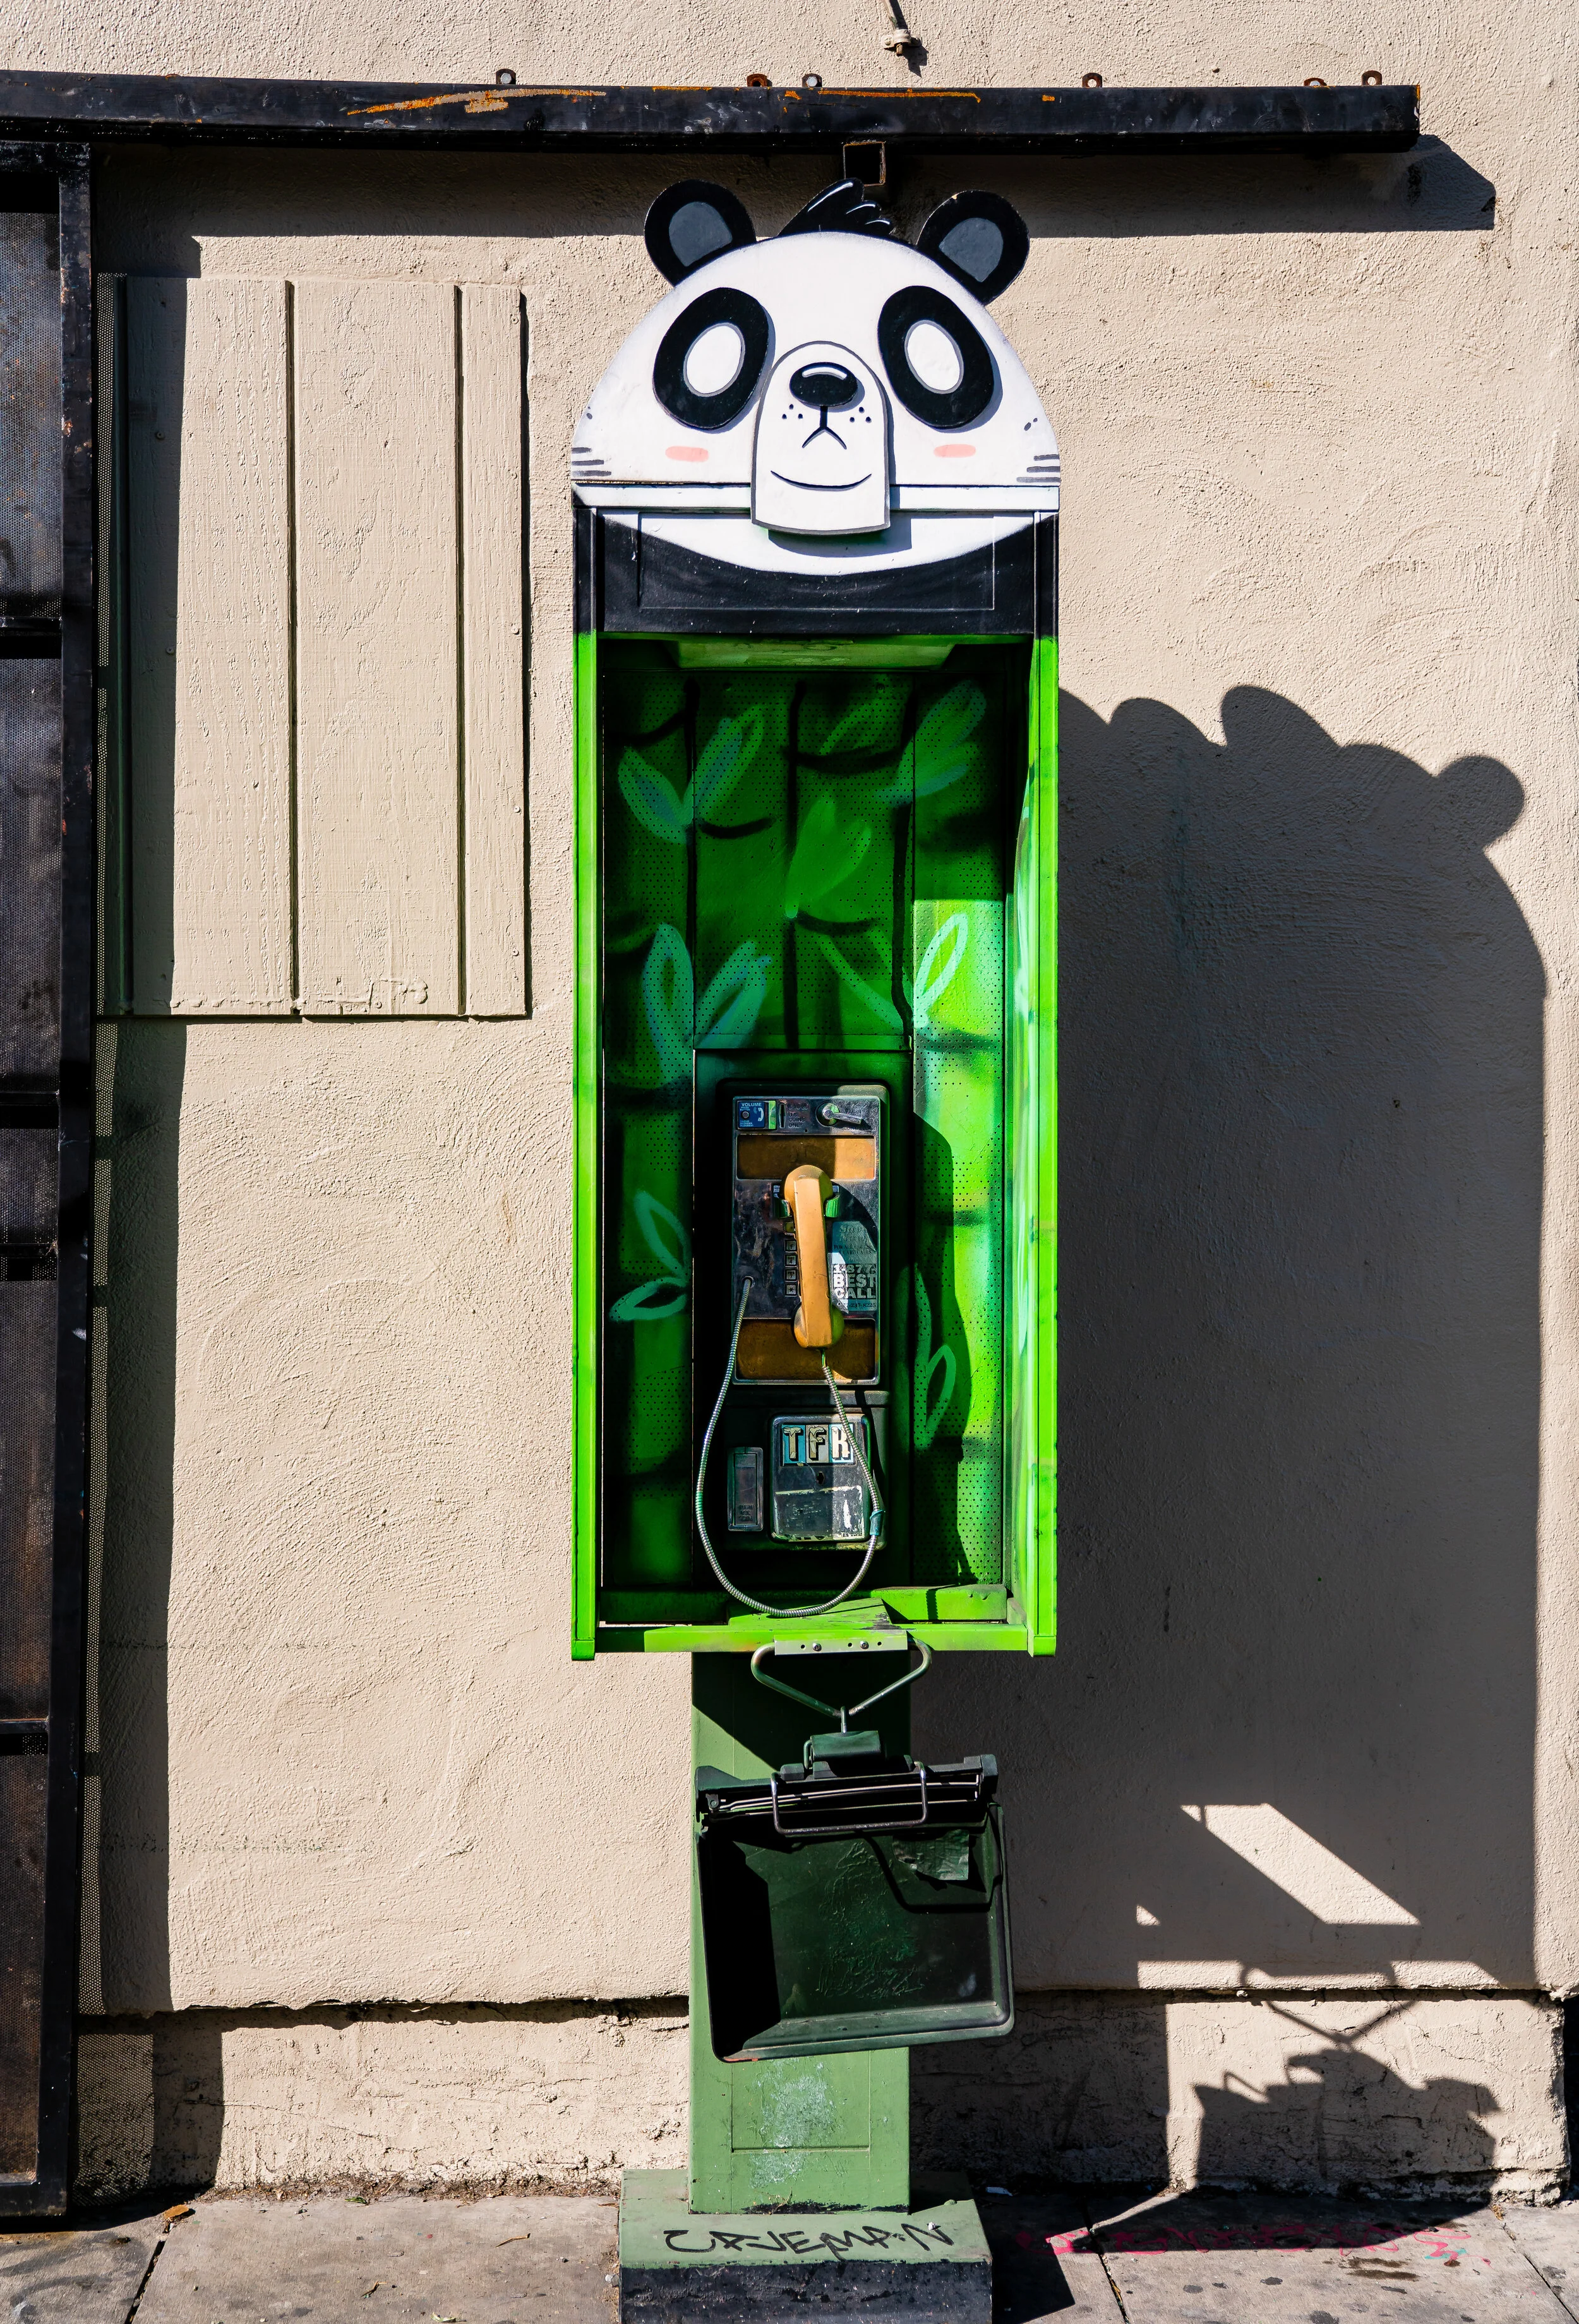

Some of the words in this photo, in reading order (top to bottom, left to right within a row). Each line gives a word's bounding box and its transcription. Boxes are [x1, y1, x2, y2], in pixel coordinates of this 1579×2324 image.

[833, 1273, 876, 1287] BEST
[834, 1287, 876, 1299] CALL
[663, 2223, 955, 2261] CAVEMAN
